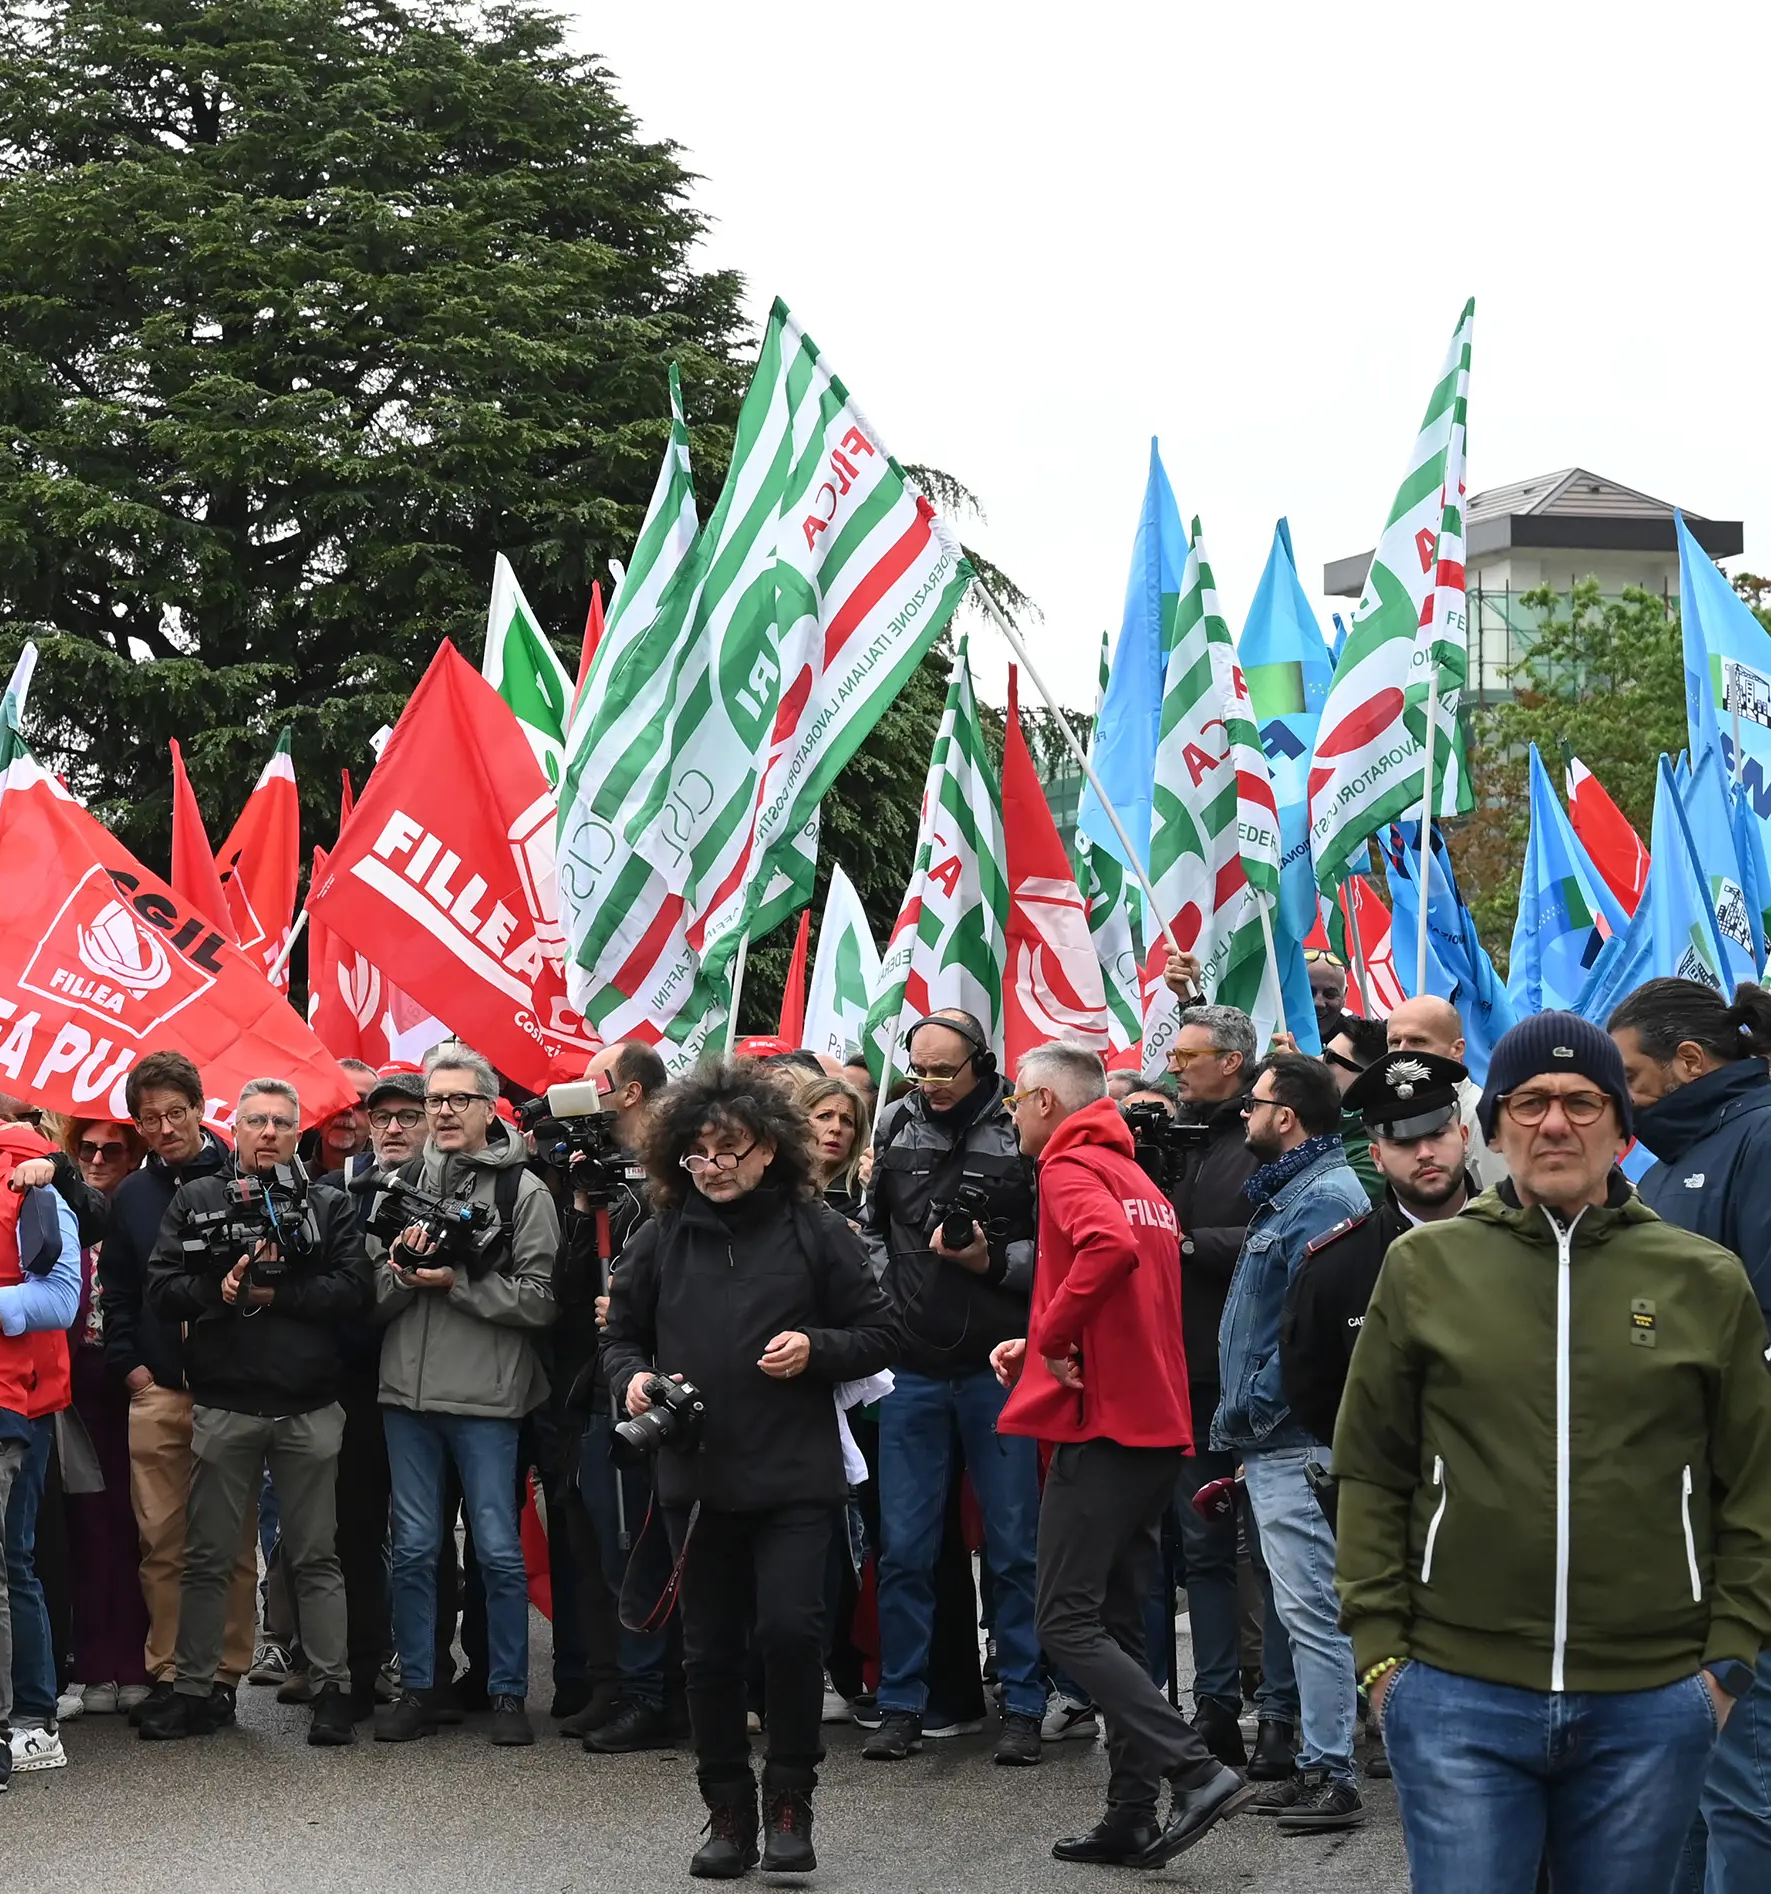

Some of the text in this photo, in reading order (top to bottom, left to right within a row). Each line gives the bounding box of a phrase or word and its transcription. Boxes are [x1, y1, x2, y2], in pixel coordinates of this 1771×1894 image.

[105, 867, 226, 974] CGIL
[372, 809, 544, 986] FILLEA
[49, 967, 126, 1014] FILLEA
[1122, 1199, 1178, 1237] FILLEA
